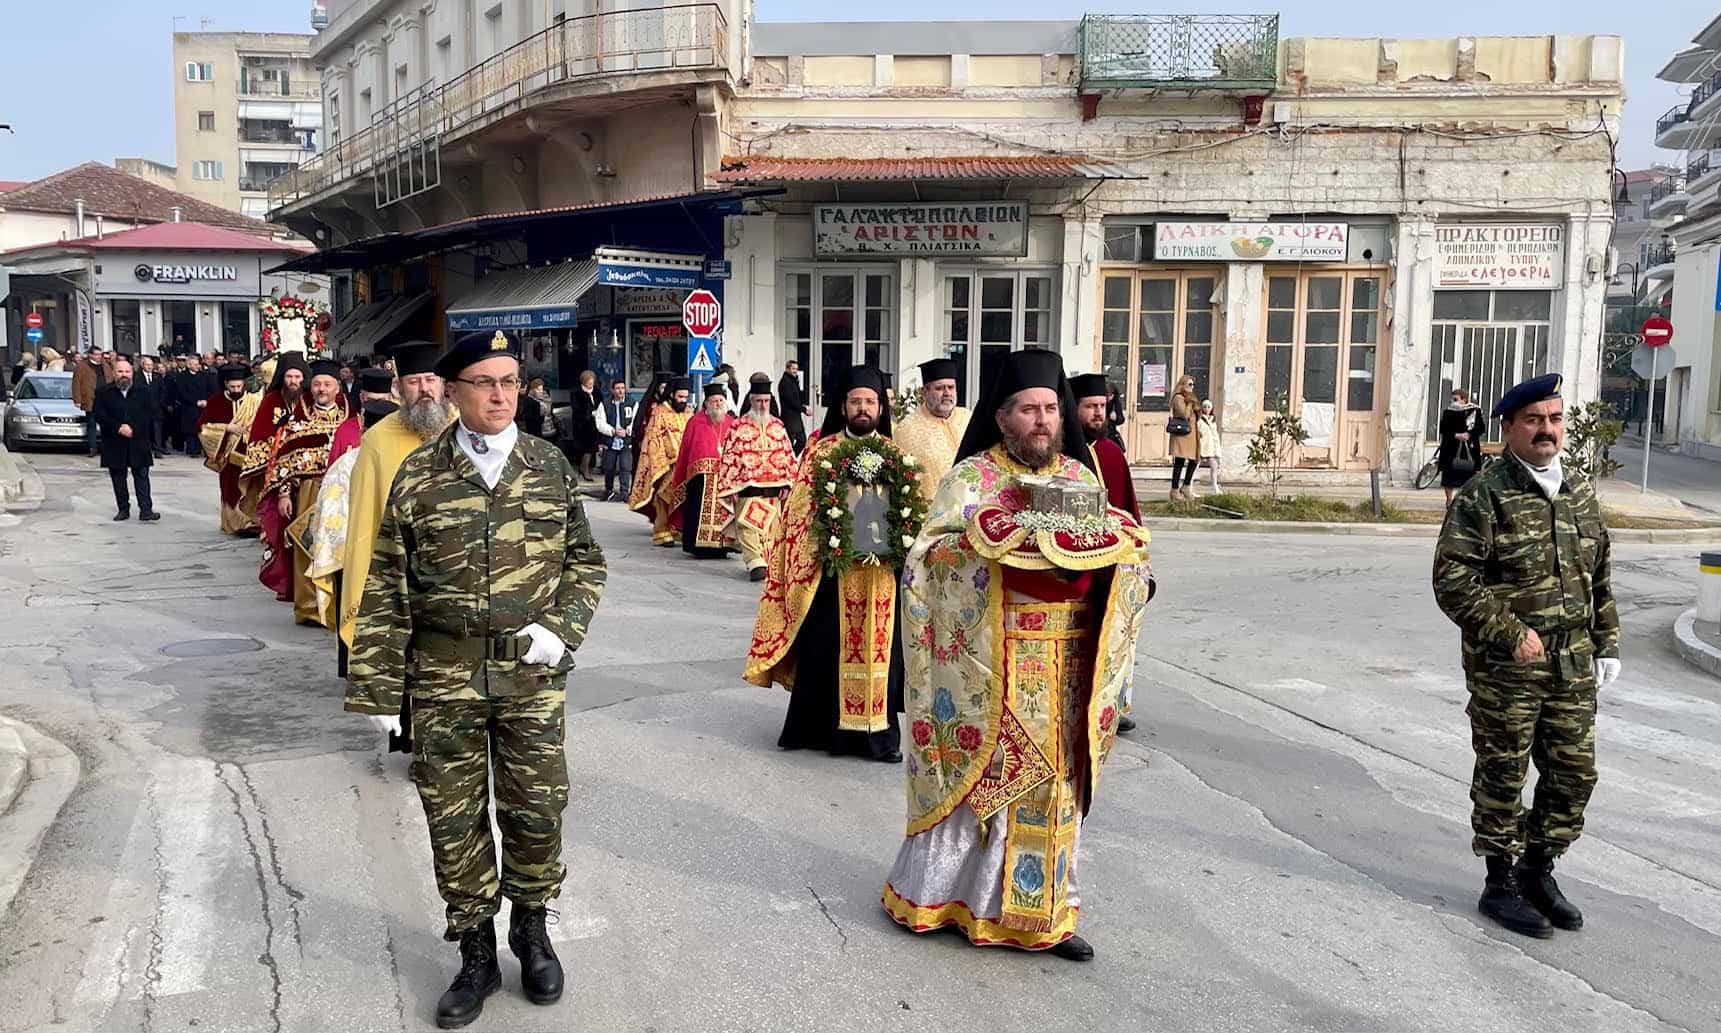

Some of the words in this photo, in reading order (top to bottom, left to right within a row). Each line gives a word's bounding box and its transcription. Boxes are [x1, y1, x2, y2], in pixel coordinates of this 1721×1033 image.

[1258, 224, 1344, 242] ΑΓΟΡΑ
[1436, 228, 1560, 242] ΠΡΑΚΤΟΡΕΙΟ
[153, 264, 237, 280] FRANKLIN
[686, 302, 718, 327] STOP
